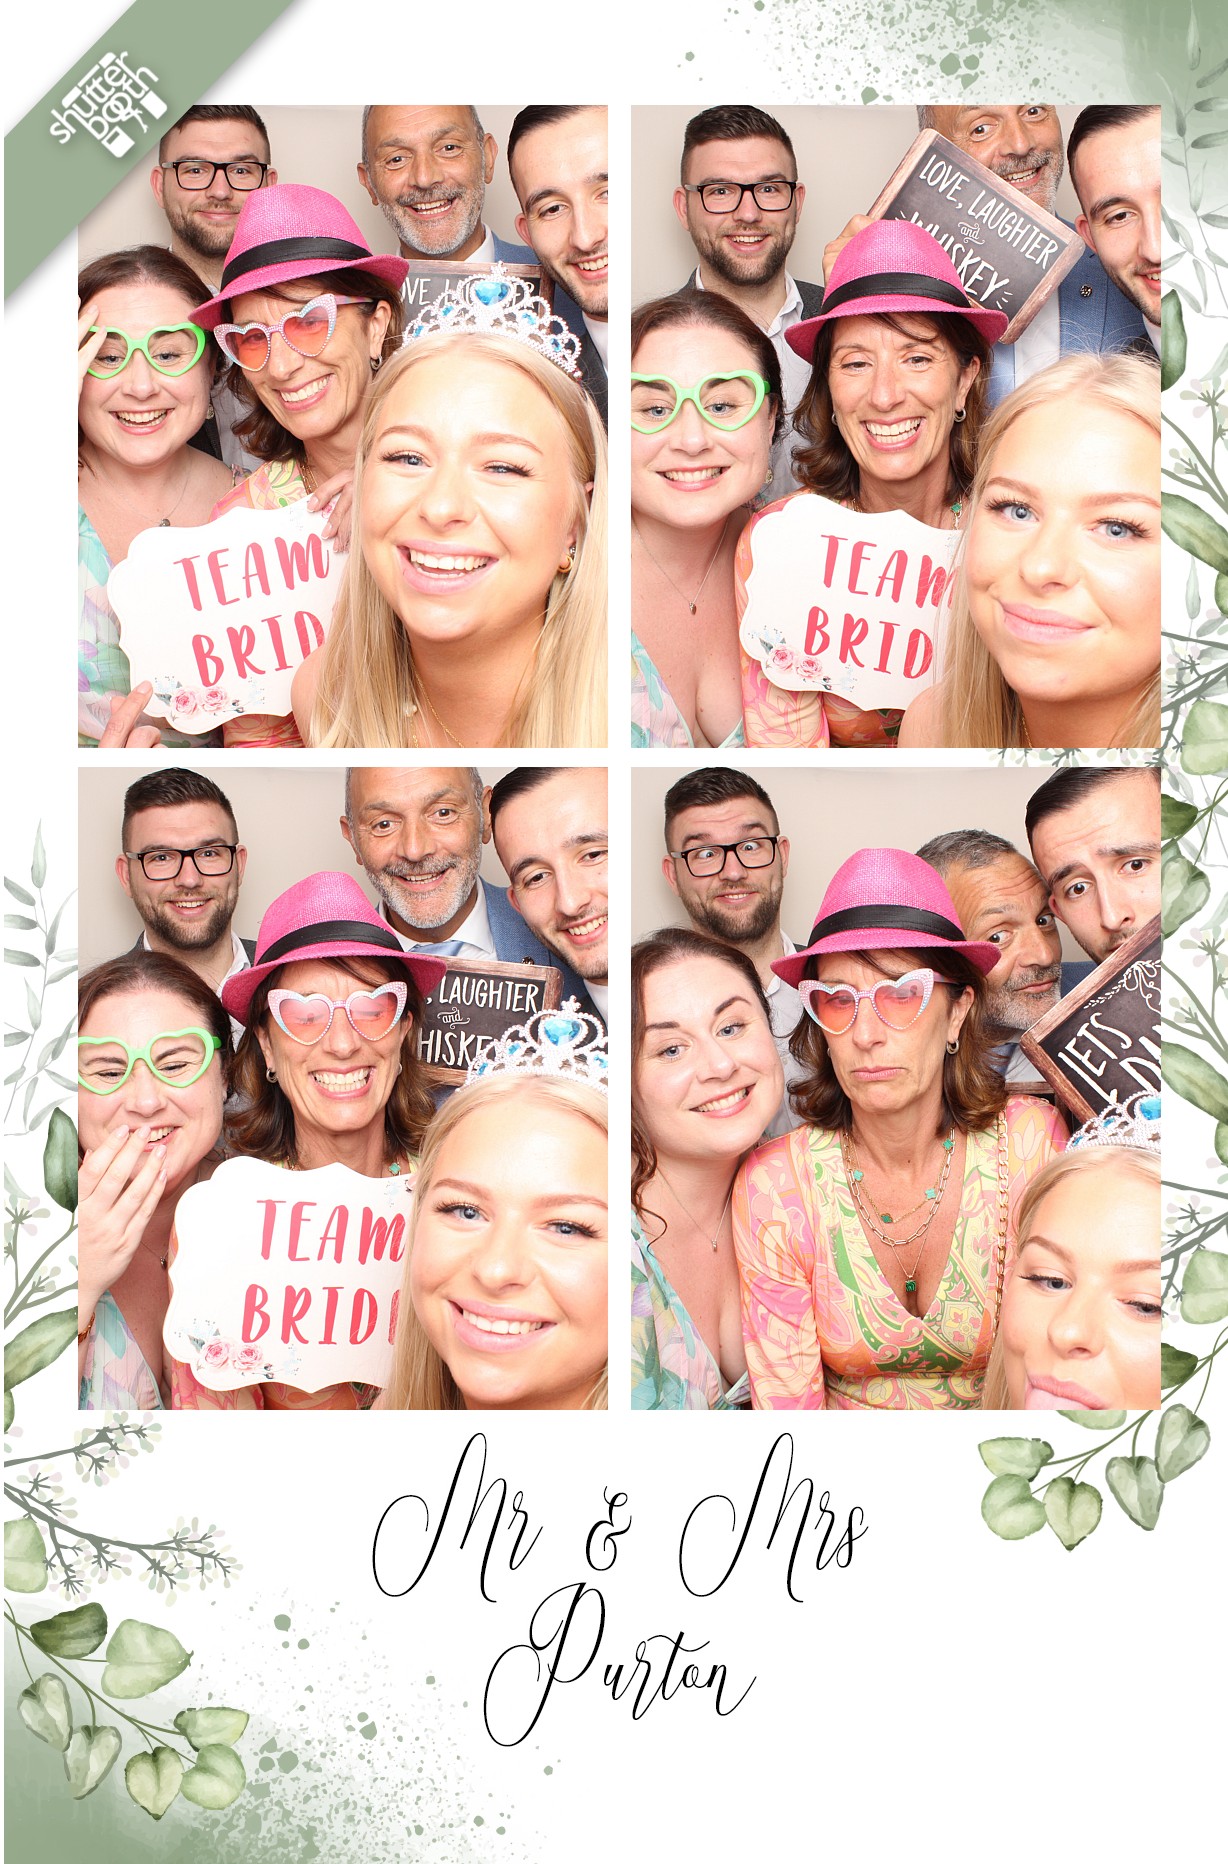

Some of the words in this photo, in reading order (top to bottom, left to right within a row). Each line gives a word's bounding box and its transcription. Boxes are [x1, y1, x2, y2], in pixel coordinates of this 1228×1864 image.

[920, 154, 969, 209] LOVE,
[968, 190, 1058, 269] LAUGHTER
[173, 533, 329, 611] TEAM
[821, 534, 960, 609] TEAM
[192, 611, 325, 687] BRID
[804, 606, 933, 679] BRID
[439, 976, 538, 1013] LAUGHTER
[256, 1199, 406, 1265] TEAM
